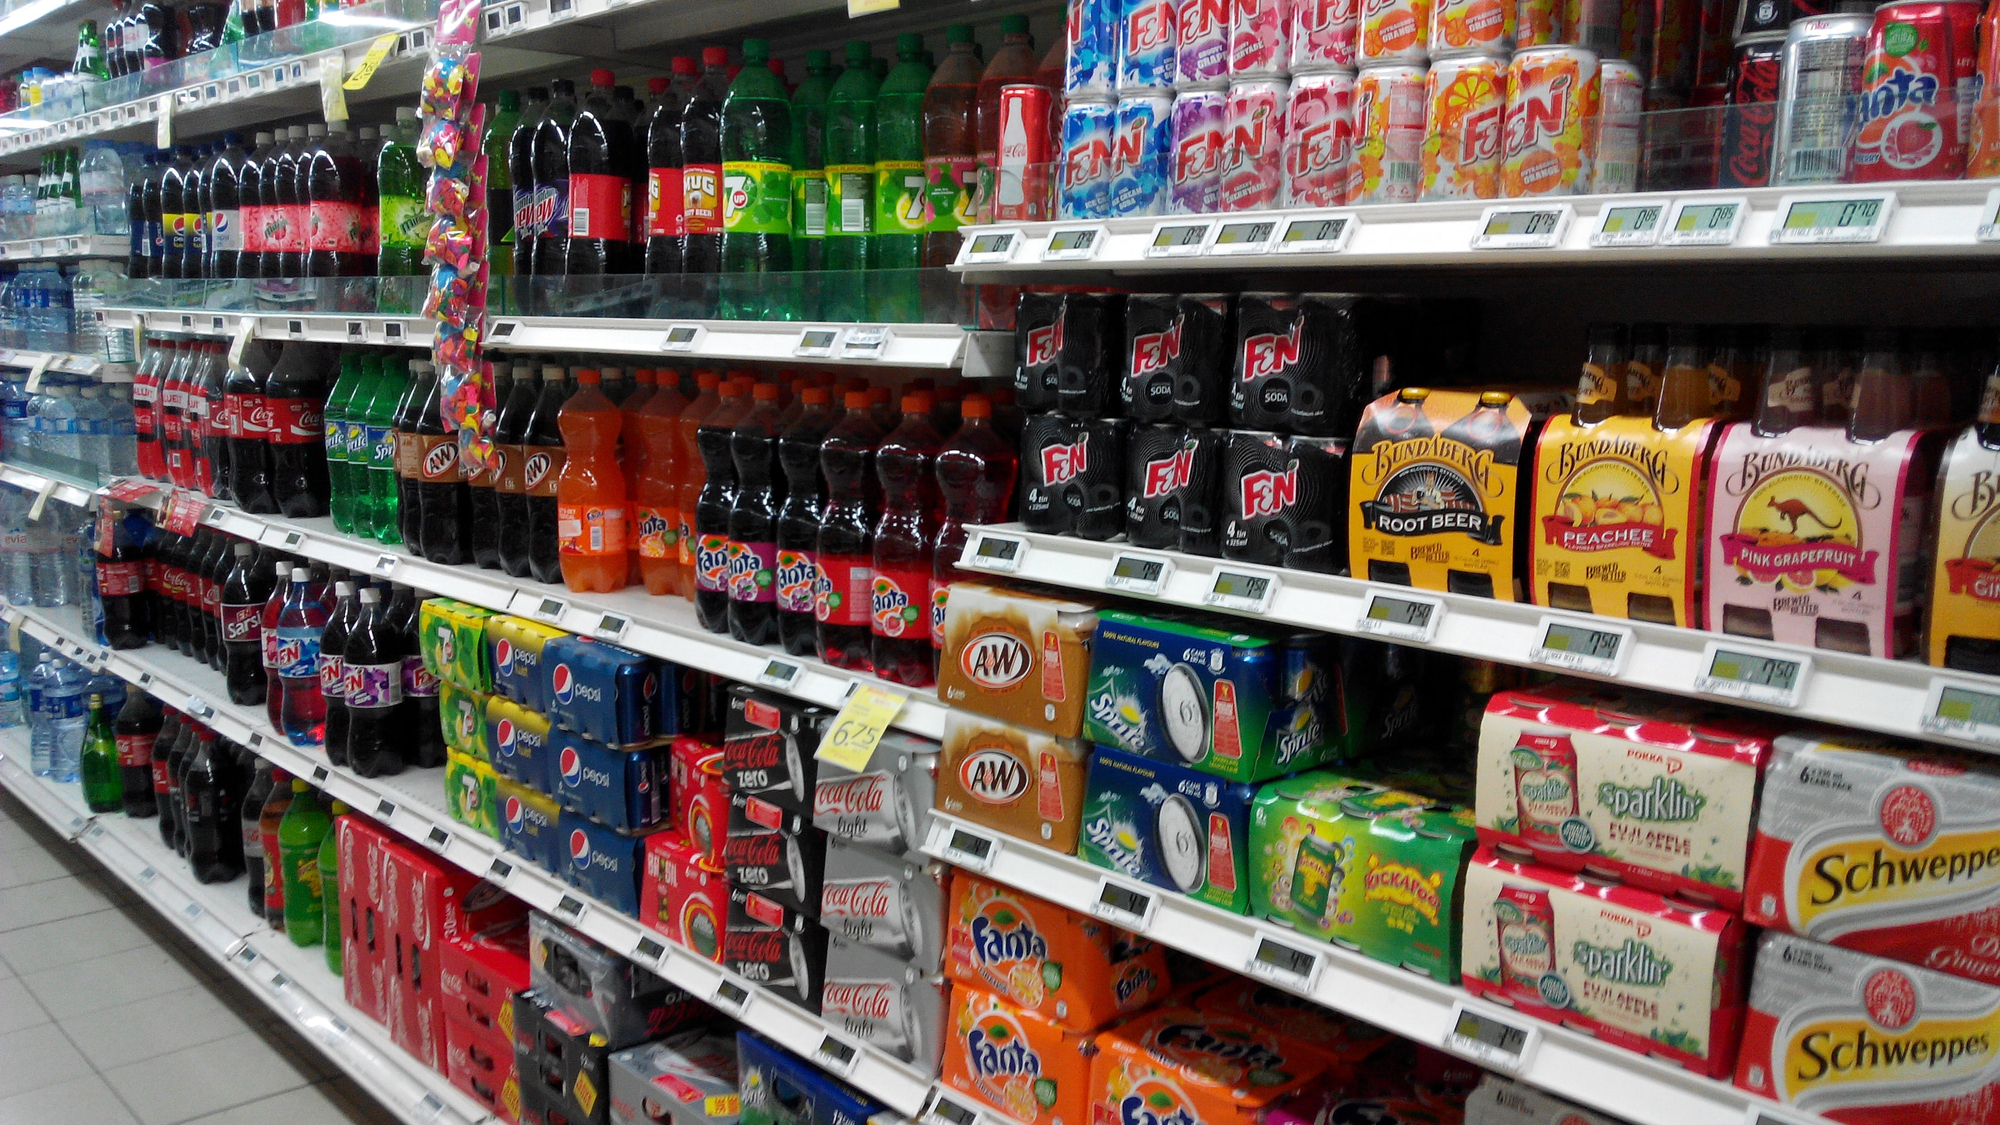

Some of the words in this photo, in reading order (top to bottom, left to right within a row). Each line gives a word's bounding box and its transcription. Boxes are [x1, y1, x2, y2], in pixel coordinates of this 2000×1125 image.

[1382, 25, 1416, 43] ORANGE
[1468, 14, 1503, 32] ORANGE
[1523, 165, 1561, 185] ORANGE
[1131, 325, 1182, 377] F&N
[1243, 328, 1301, 382] F&N
[1150, 385, 1172, 396] SODA
[1264, 392, 1289, 404] SODA
[1041, 443, 1087, 487] F&N
[1144, 448, 1196, 499] F&N
[1362, 437, 1504, 498] BUNDABERG
[1546, 436, 1679, 495] BUNDABERG
[1028, 488, 1038, 501] 4
[1127, 497, 1136, 513] 4
[1241, 469, 1299, 520] F&N
[1226, 520, 1236, 538] 4
[1379, 514, 1428, 532] ROOT
[1431, 513, 1482, 531] BEER
[1563, 528, 1654, 545] PEACHEE
[1741, 549, 1770, 567] PINK
[1774, 549, 1857, 568] GRAPEFRUIT
[227, 609, 261, 639] Sarsi
[514, 648, 537, 667] pepsi
[972, 641, 1021, 678] A&W
[1183, 648, 1191, 661] 6
[574, 682, 602, 703] pepsi
[1091, 692, 1146, 749] Sprite
[517, 729, 541, 748] pepsi
[1276, 723, 1321, 766] Sprite
[582, 766, 610, 789] pepsi
[737, 769, 769, 788] zero
[970, 759, 1019, 793] A&W
[1178, 779, 1186, 793] 6
[1800, 766, 1811, 784] 6
[524, 809, 548, 827] pepsi
[837, 815, 869, 838] light
[1086, 817, 1141, 875] Sprite
[591, 850, 619, 873] pepsi
[737, 865, 769, 885] zero
[1811, 846, 2000, 907] Schweppe
[1365, 870, 1442, 914] KICKAPOO
[843, 919, 875, 940] light
[971, 915, 1048, 966] Fanta
[1783, 945, 1792, 963] 6
[737, 960, 770, 982] zero
[844, 1018, 877, 1040] light
[968, 1029, 1042, 1079] Fanta
[1798, 1028, 1990, 1082] Schweppes
